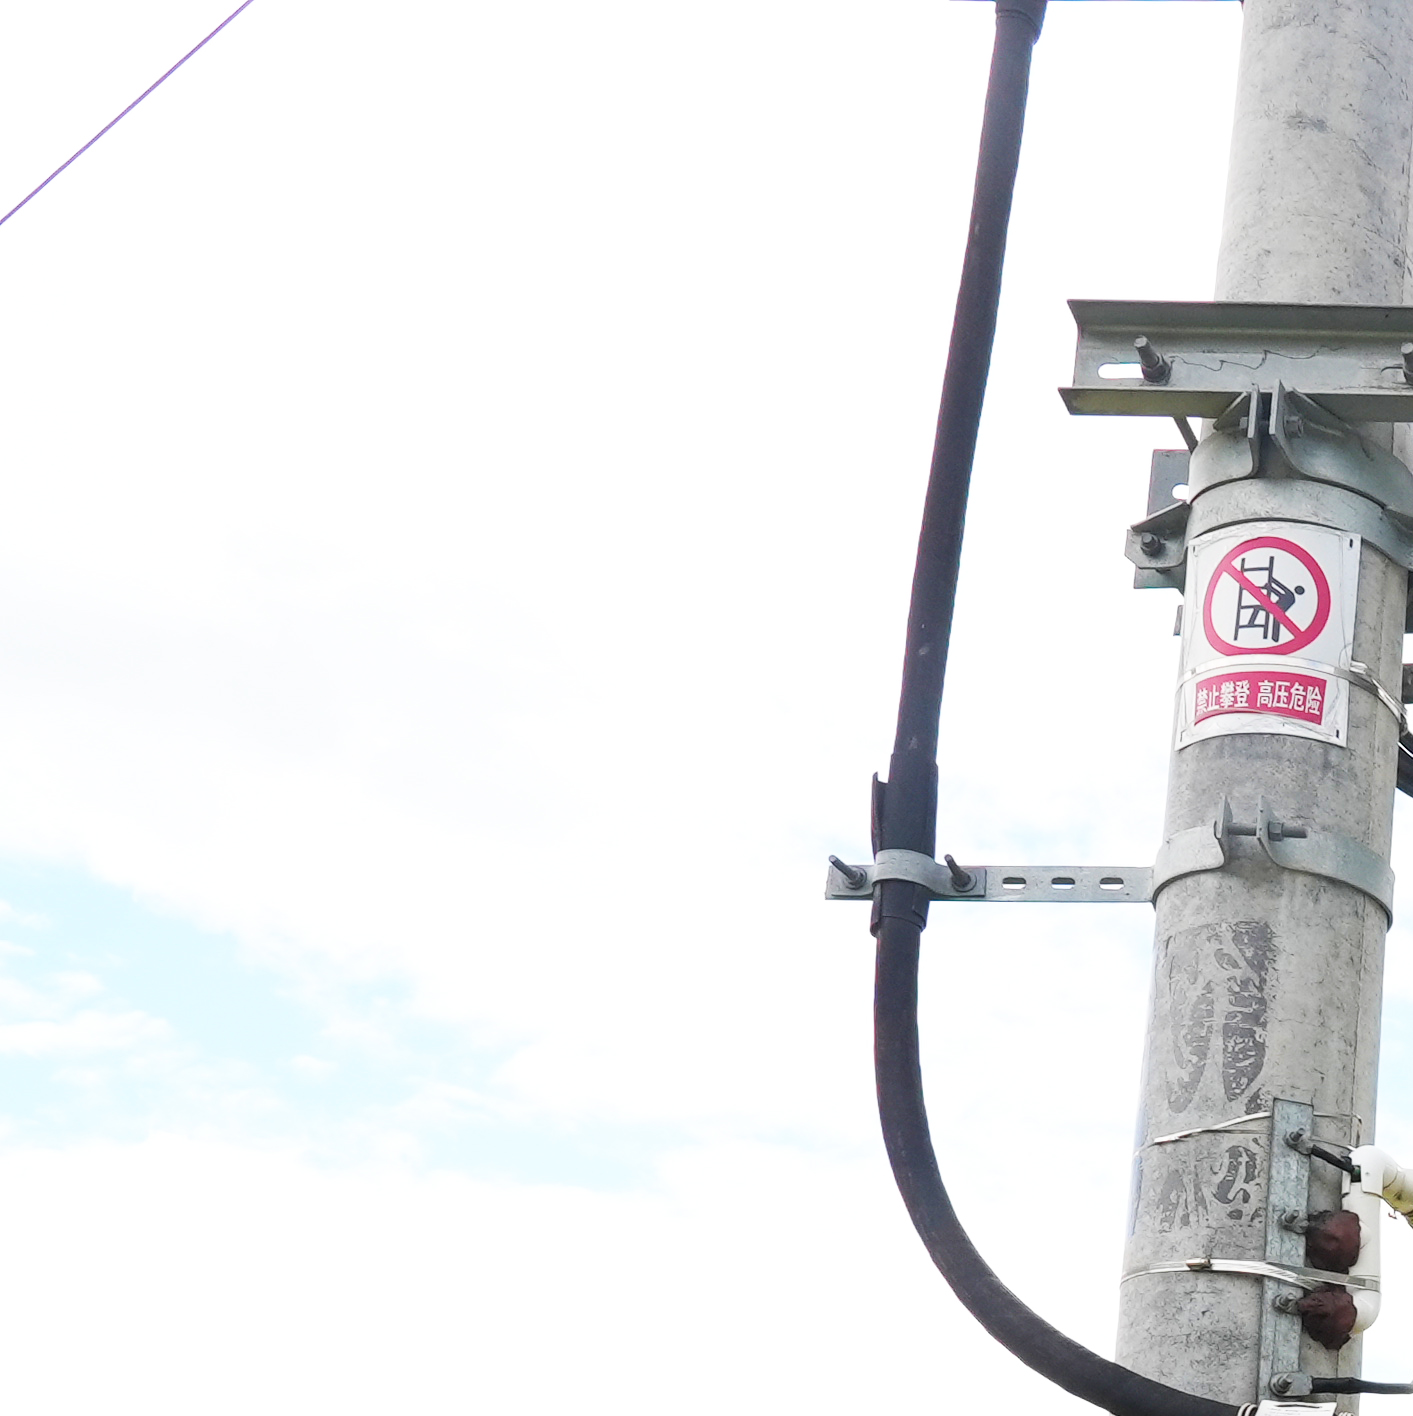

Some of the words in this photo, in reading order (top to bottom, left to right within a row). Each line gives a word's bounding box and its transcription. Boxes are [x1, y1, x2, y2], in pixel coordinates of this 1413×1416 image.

[1196, 680, 1250, 716] 禁止攀登
[1256, 680, 1323, 715] 高压危险
